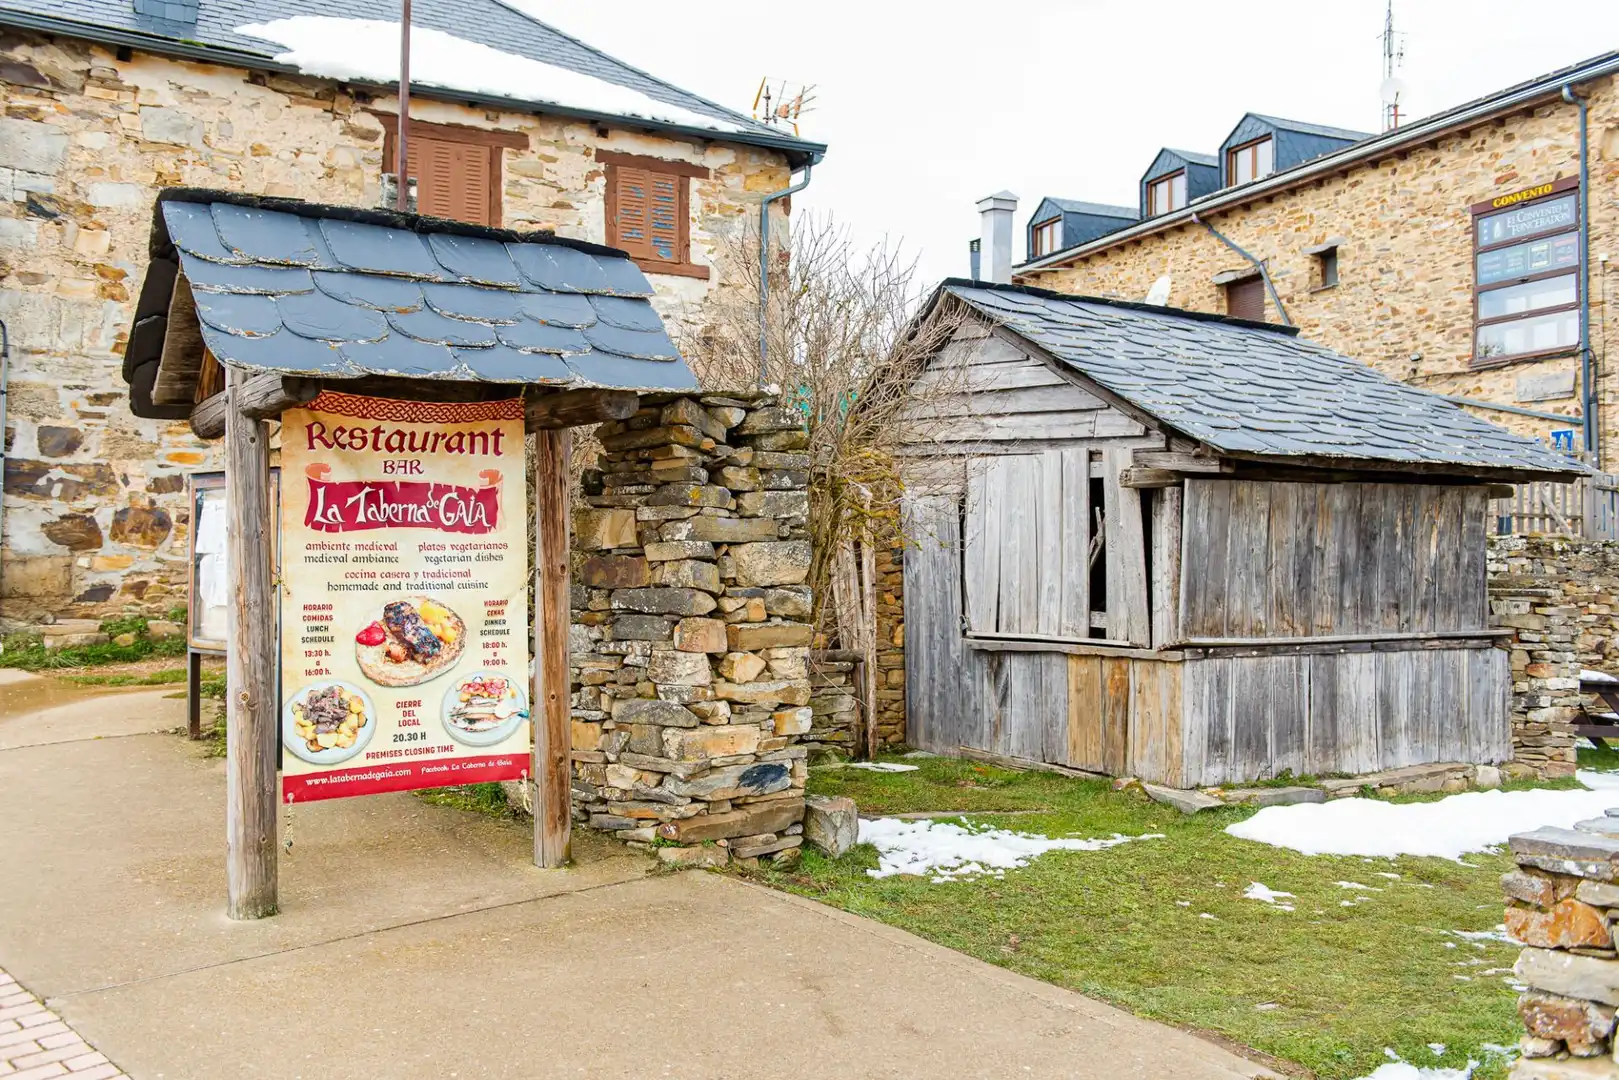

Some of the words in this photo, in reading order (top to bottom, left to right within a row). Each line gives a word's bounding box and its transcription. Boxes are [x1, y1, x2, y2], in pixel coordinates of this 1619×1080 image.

[1492, 184, 1552, 208] CONVENTO
[304, 422, 505, 456] Restaurant
[383, 459, 424, 475] BAR
[313, 486, 346, 524] La
[345, 486, 431, 524] Taberna
[426, 490, 439, 508] de
[306, 541, 350, 551] ambiente
[355, 541, 398, 551] medieval
[418, 542, 446, 553] platos
[450, 541, 508, 553] vegetarianos
[304, 553, 348, 563] medieval
[352, 554, 399, 563] ambiance
[424, 554, 472, 565] vegetarian
[475, 552, 504, 562] dishes
[345, 569, 376, 579] cocina
[380, 571, 410, 579] casera
[414, 571, 419, 580] y
[422, 569, 472, 579] tradicional
[328, 581, 379, 592] homemade
[382, 581, 402, 591] and
[406, 581, 454, 591] traditional
[458, 580, 489, 590] cuisine
[484, 599, 508, 607] HORARIO
[305, 668, 323, 676] 16:00
[396, 700, 422, 708] CIERRE
[398, 719, 421, 727] LOCAL
[393, 732, 418, 743] 20.30
[421, 732, 426, 740] H
[366, 750, 403, 760] PREMISES
[404, 747, 435, 756] CLOSING
[306, 769, 412, 786] www.latabernadegaia.com
